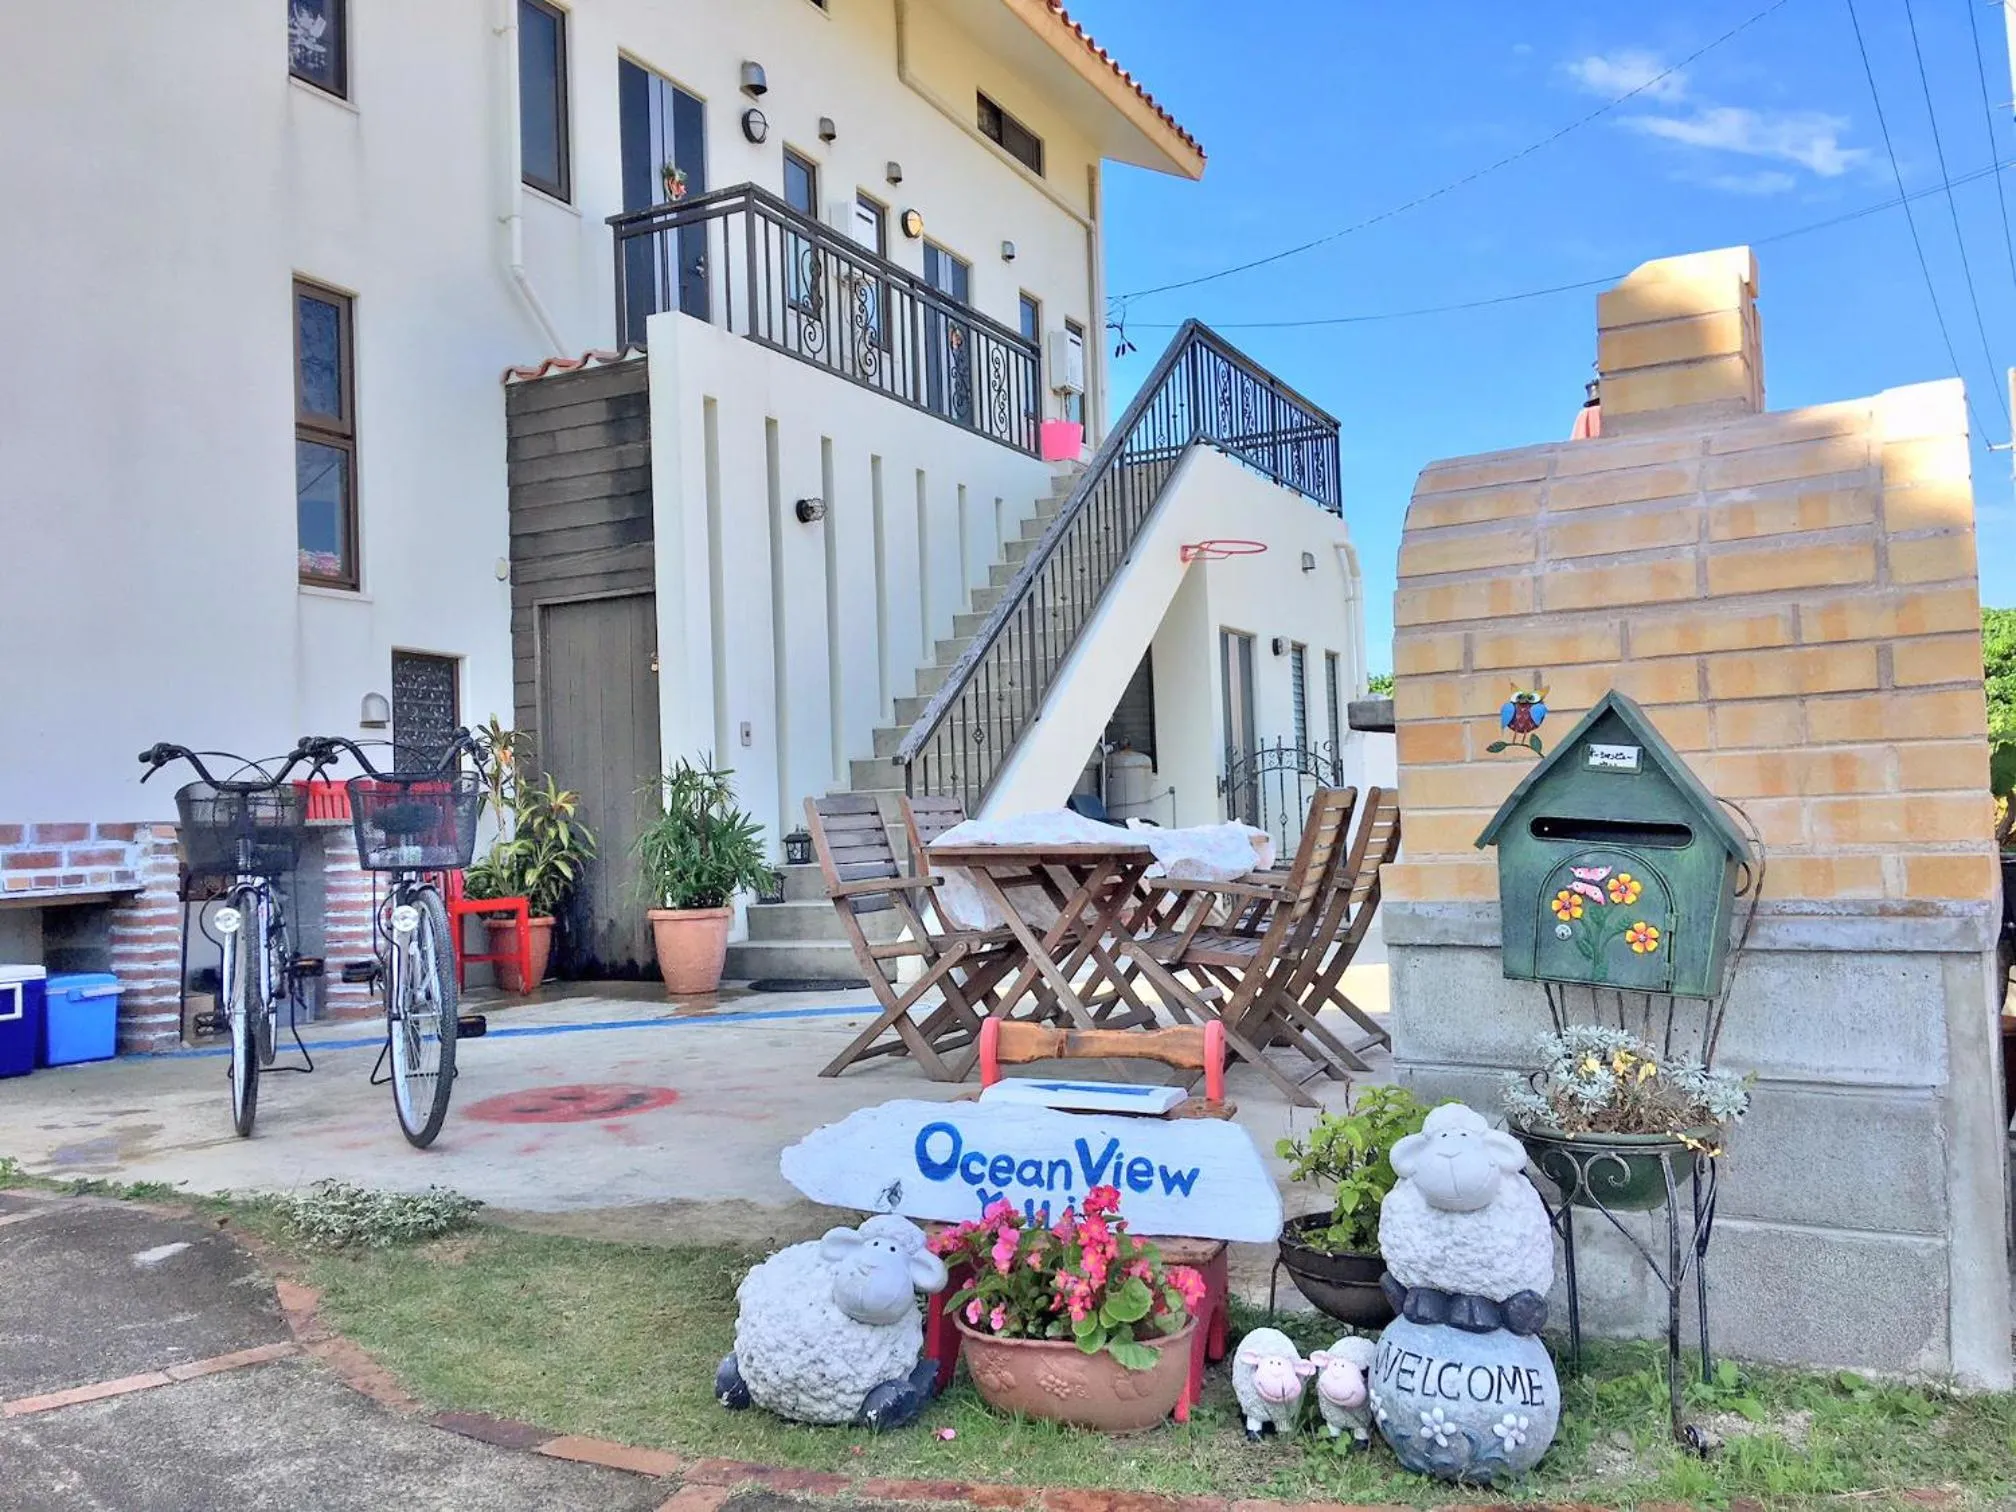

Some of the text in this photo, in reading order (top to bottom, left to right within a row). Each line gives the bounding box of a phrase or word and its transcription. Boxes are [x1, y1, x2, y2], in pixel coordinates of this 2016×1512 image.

[915, 1121, 1200, 1197] Ocean View
[1374, 1340, 1545, 1406] WELCOME
